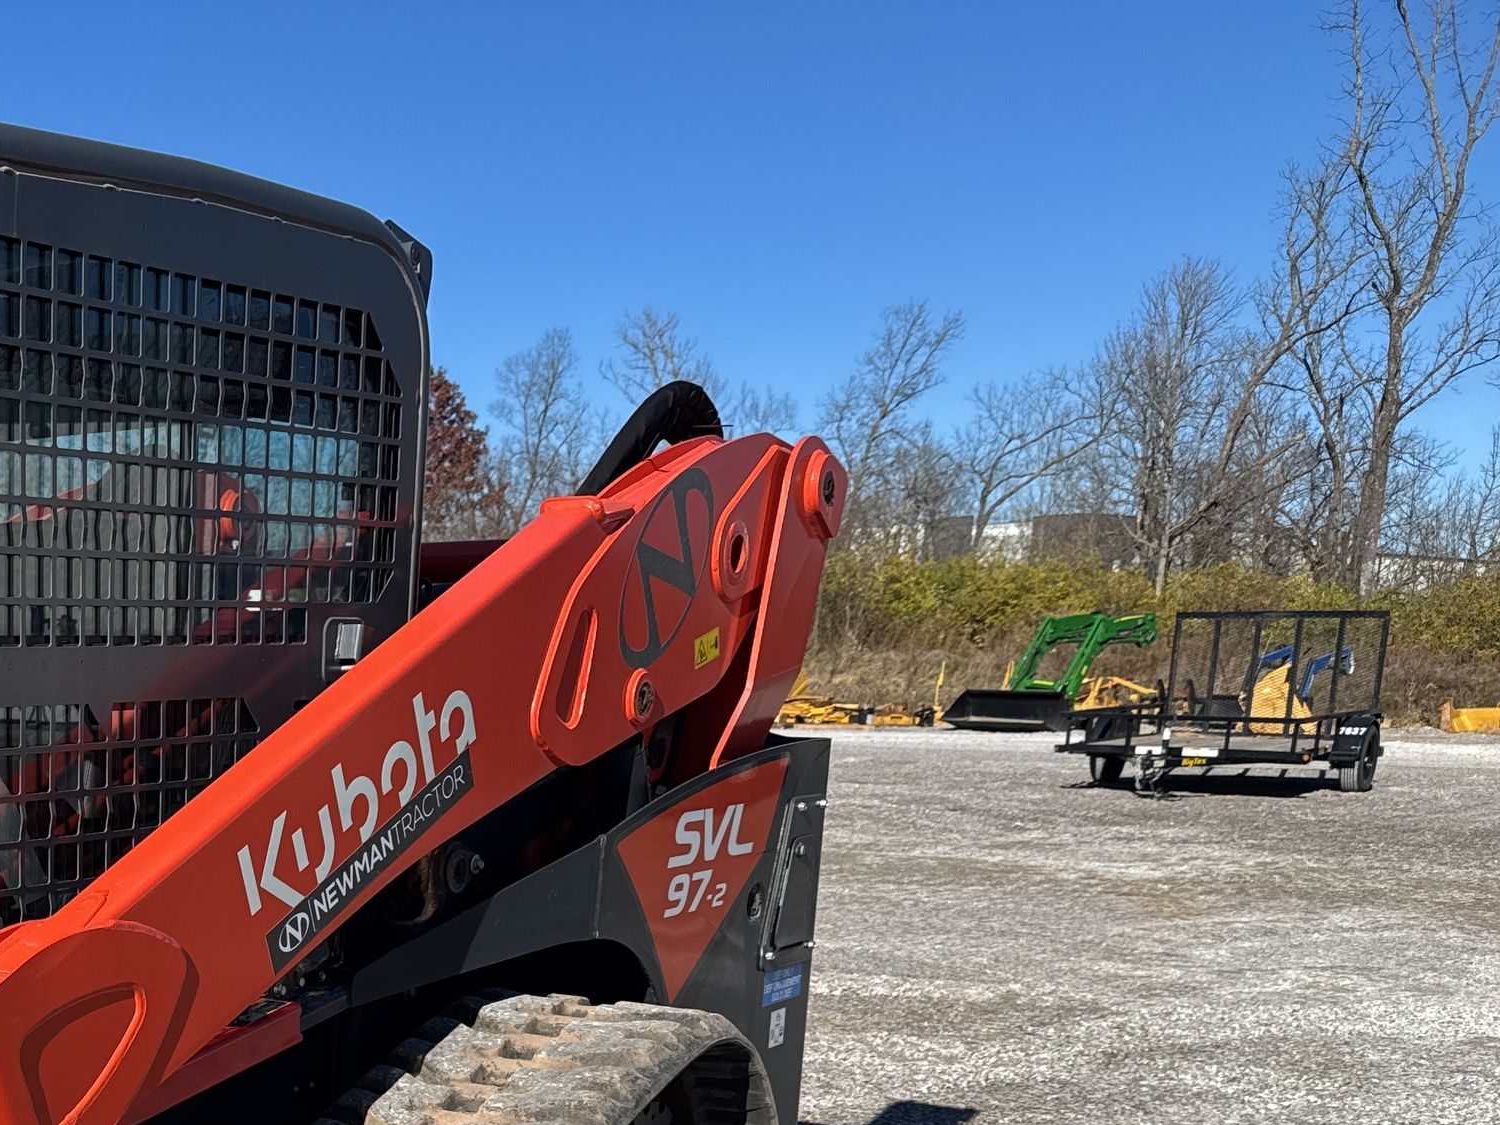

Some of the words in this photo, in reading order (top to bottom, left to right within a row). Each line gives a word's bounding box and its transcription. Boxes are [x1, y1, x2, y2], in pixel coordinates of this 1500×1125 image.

[237, 690, 477, 917] Kubota
[313, 764, 466, 921] NEWMANTRACTOR
[667, 803, 754, 869] SVL
[663, 869, 727, 918] 97-2
